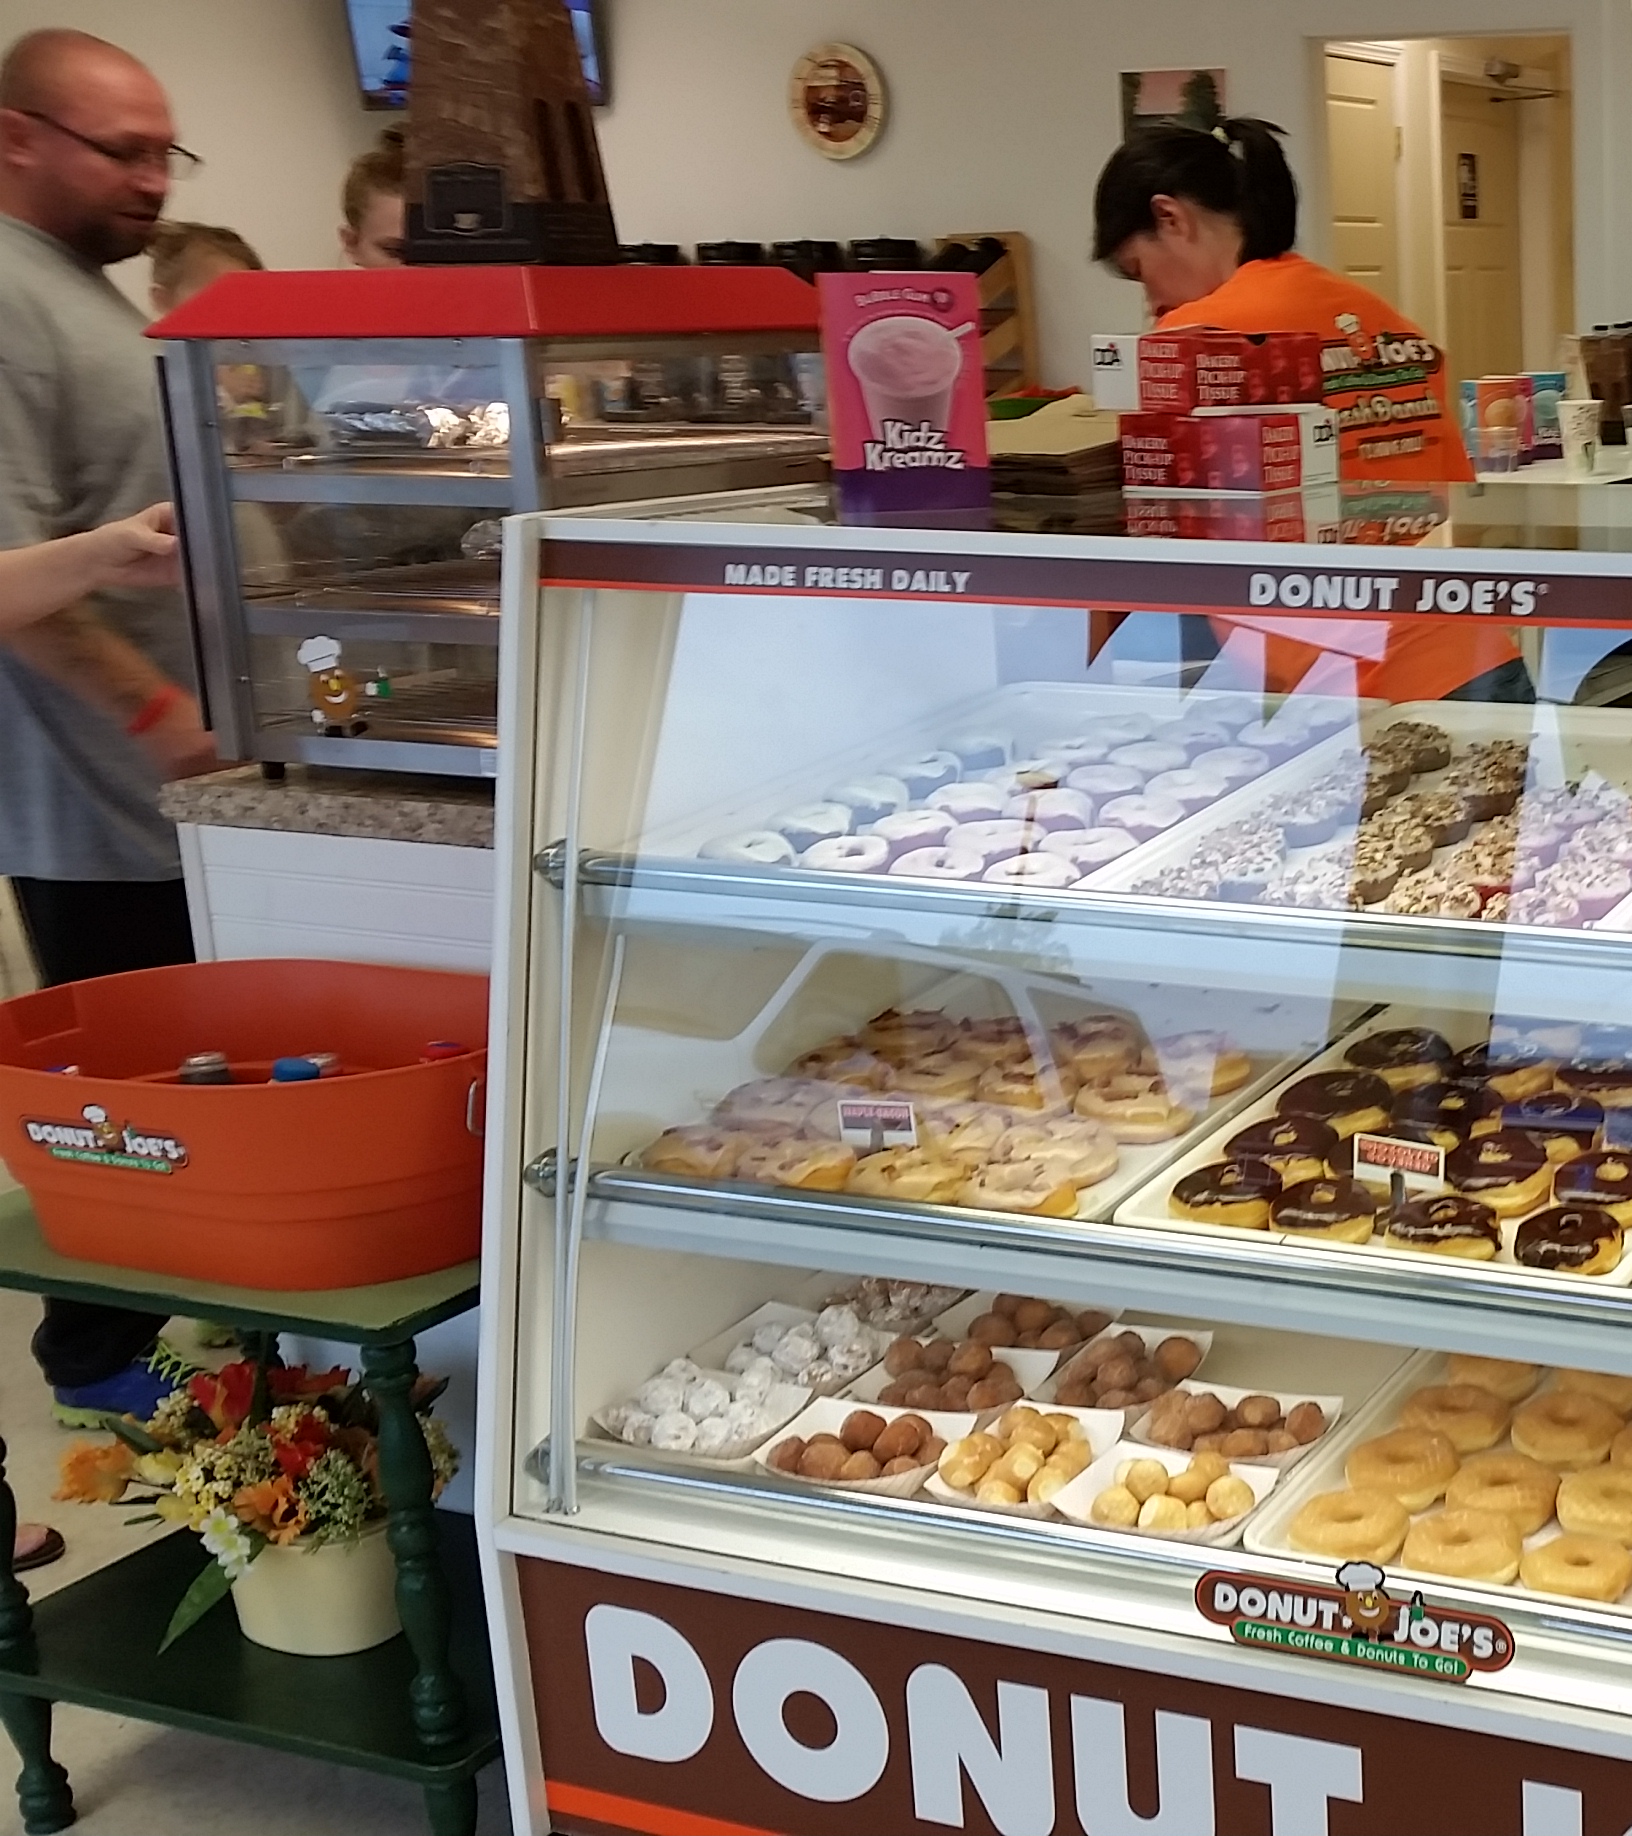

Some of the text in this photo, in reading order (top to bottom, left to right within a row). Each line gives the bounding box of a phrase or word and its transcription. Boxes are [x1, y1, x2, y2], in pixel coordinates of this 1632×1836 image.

[883, 419, 946, 450] Kidz
[863, 441, 966, 471] Kreamz
[724, 563, 972, 593] MADE FRESH DAILY
[1250, 572, 1537, 616] DONUT JOE'S
[27, 1122, 180, 1160] DONUT JOE'S
[1214, 1582, 1494, 1660] DONUT JOE'S
[1244, 1624, 1459, 1675] Fresh Coffee & Donuts To Go!
[585, 1603, 1363, 1836] DONUT
